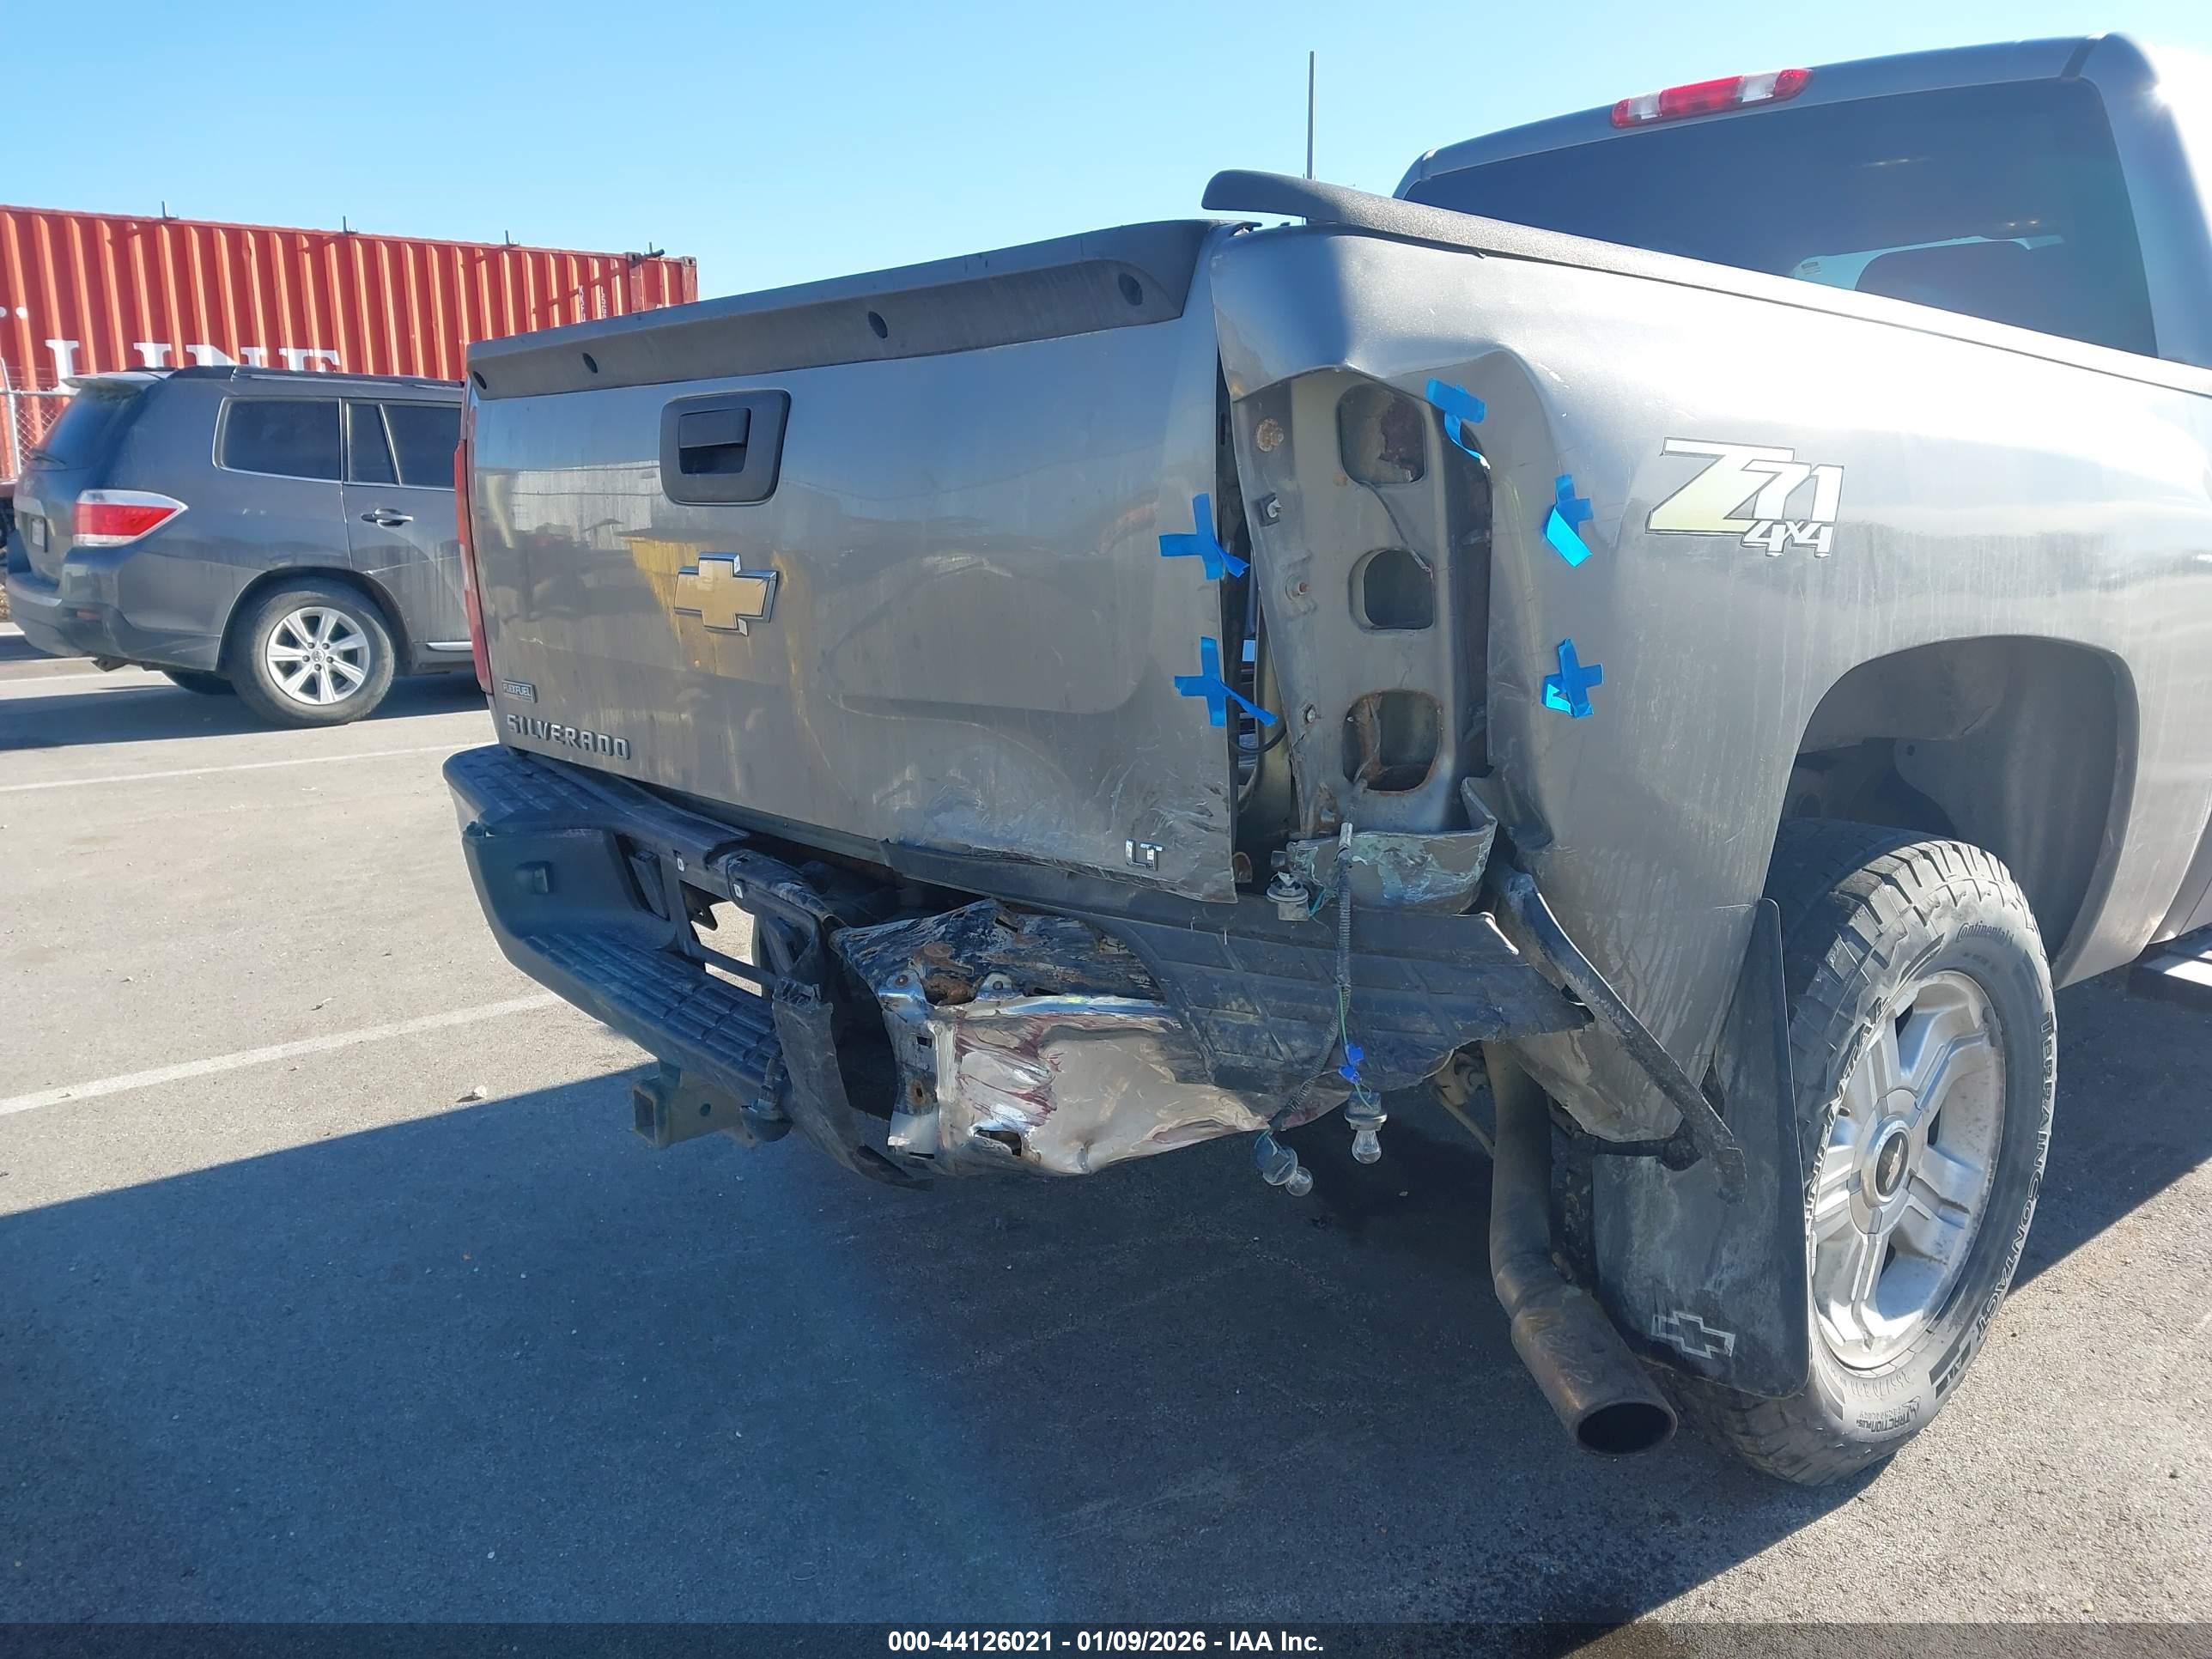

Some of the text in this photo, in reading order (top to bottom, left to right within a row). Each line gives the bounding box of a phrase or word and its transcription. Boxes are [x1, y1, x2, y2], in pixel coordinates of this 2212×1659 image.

[1645, 436, 1844, 536] Z71
[506, 714, 631, 761] SILVERADO
[1125, 838, 1164, 871] LT
